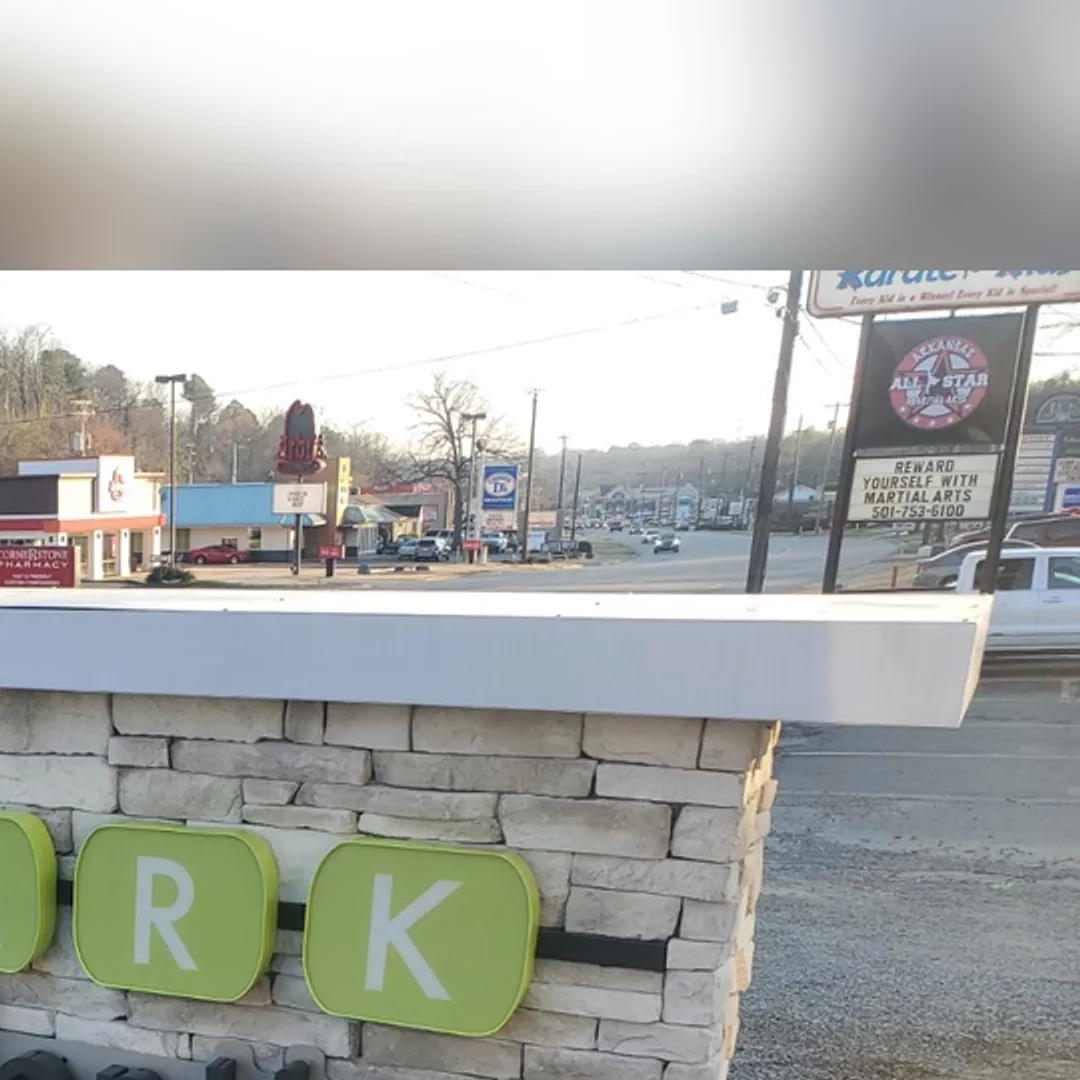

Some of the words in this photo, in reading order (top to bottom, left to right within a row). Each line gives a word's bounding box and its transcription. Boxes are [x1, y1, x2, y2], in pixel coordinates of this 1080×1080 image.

[889, 376, 919, 390] ALL
[942, 372, 988, 388] STAR
[894, 460, 955, 474] REWARD
[863, 475, 933, 490] YOURSELF
[940, 474, 979, 488] WITH
[864, 491, 928, 504] MARTIAL
[933, 490, 973, 503] ARTS
[872, 504, 965, 519] 501-753-6100
